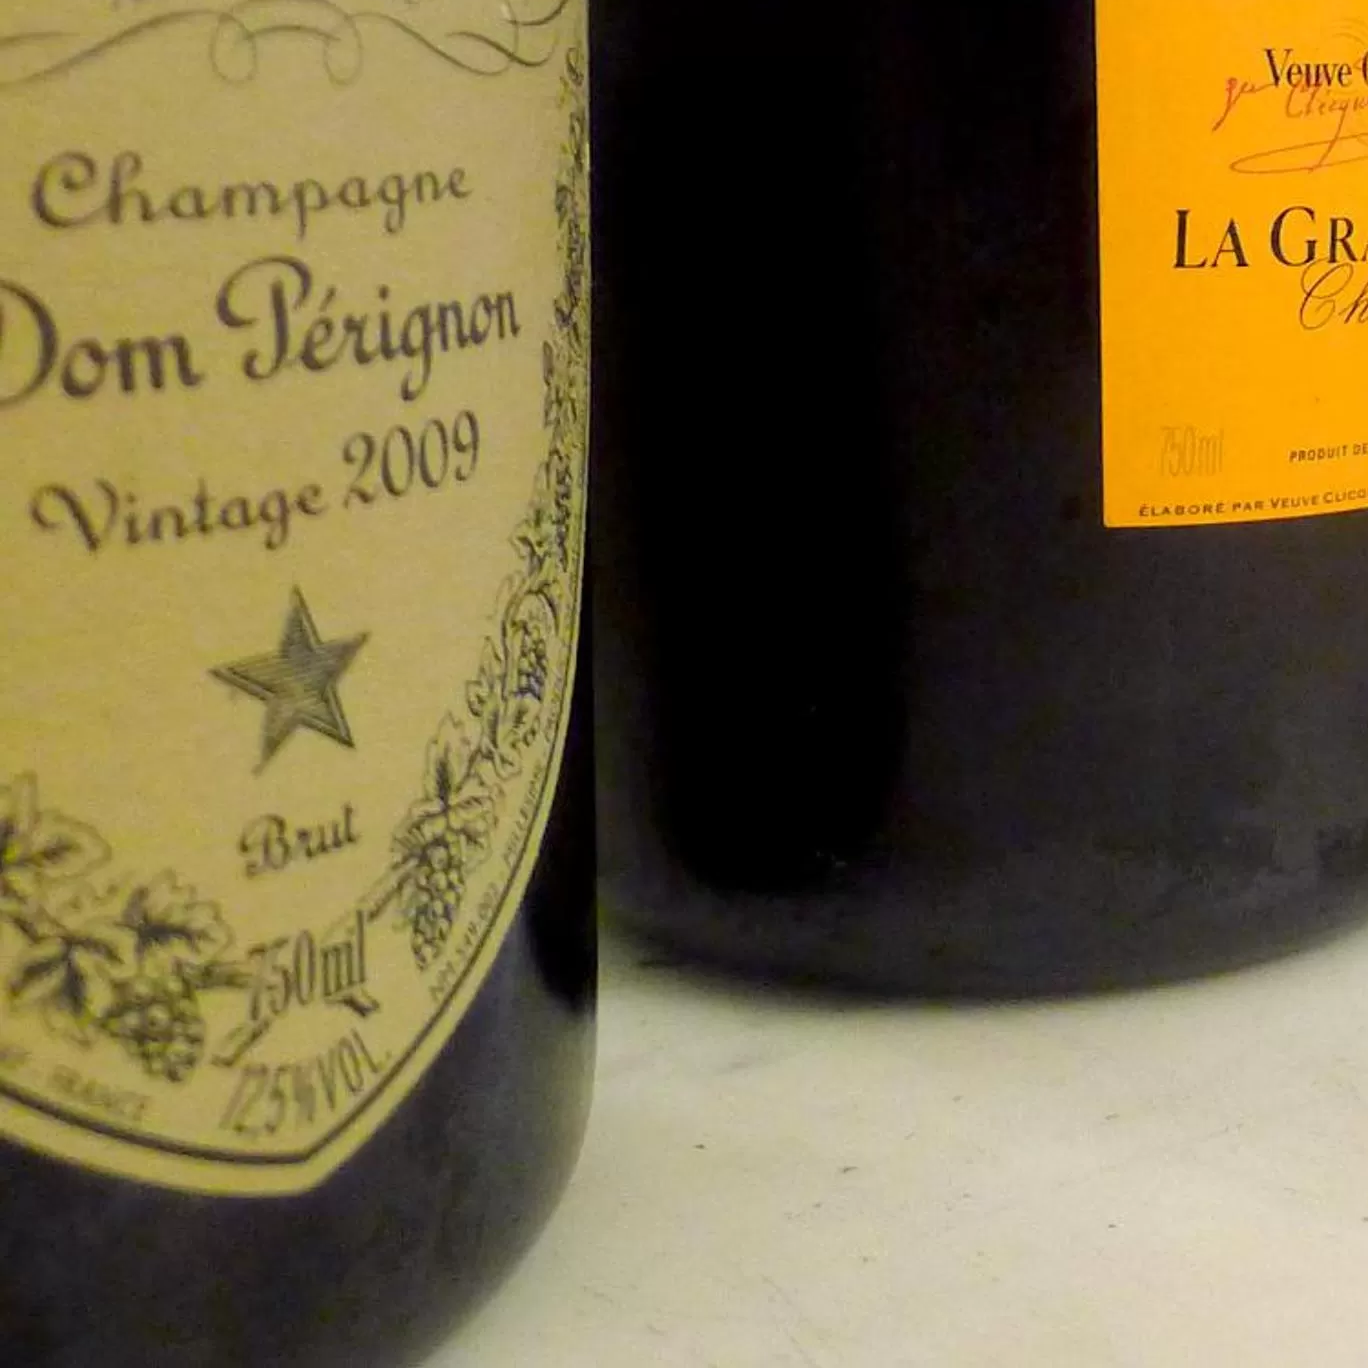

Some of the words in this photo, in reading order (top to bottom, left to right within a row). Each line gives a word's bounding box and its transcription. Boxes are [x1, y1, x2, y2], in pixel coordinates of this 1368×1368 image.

[1264, 47, 1353, 88] Veuve
[30, 149, 475, 242] Champagne
[1173, 208, 1250, 269] LA
[0, 278, 205, 410] Dom
[214, 252, 522, 404] Pérignon
[30, 477, 328, 554] Vintage
[341, 409, 482, 507] 2009
[1289, 445, 1348, 463] PRODUIT
[1232, 500, 1265, 513] PAR
[1270, 492, 1321, 511] VEUVE
[237, 803, 361, 880] Brut
